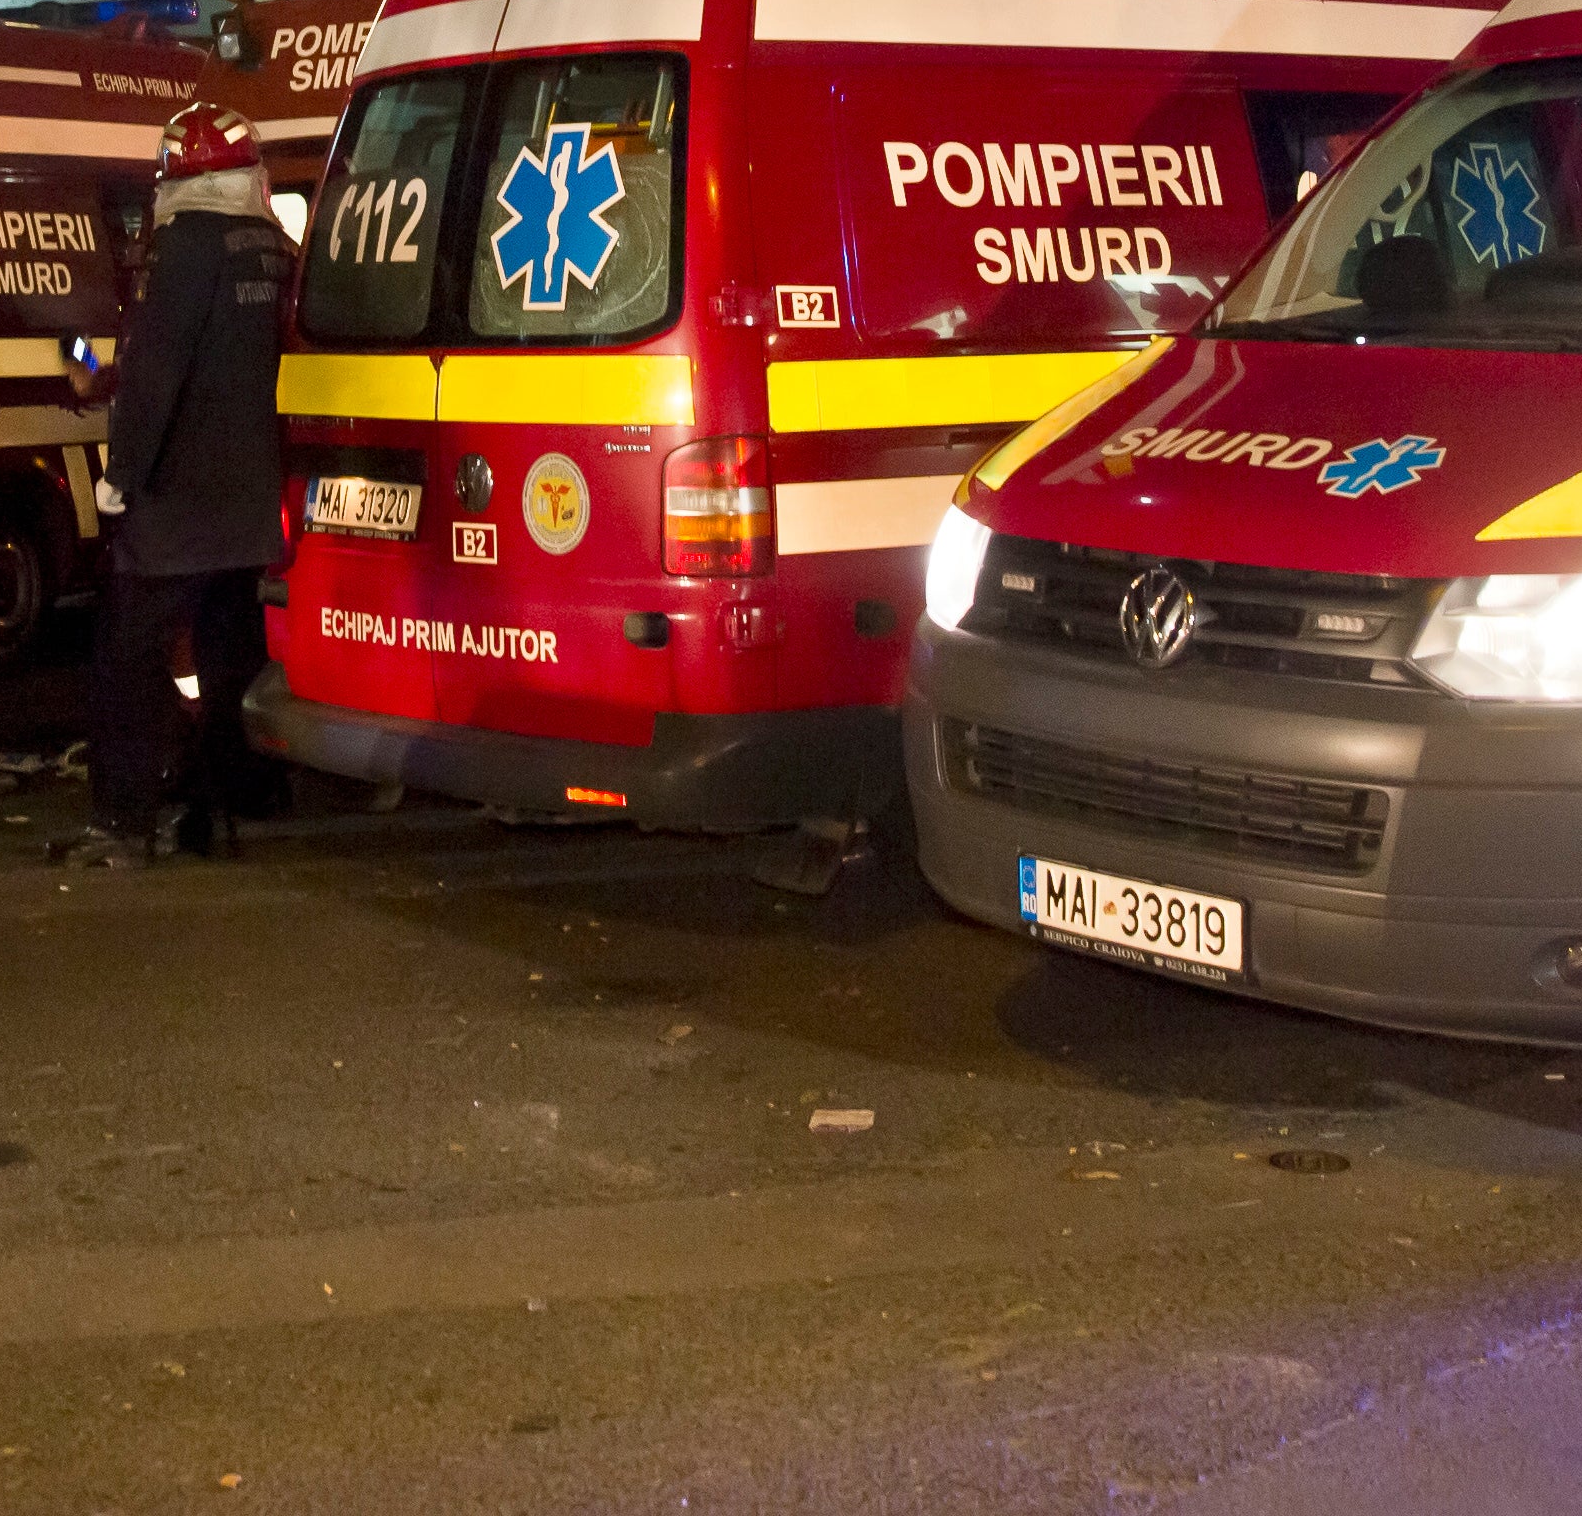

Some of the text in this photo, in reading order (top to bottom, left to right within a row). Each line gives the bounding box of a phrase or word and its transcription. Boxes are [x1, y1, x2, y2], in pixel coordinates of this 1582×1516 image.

[271, 21, 373, 60] POMP
[93, 72, 144, 96] ECHIPAJ
[144, 77, 174, 98] PRIM
[883, 141, 1223, 208] POMPIERII
[353, 177, 428, 264] 112
[974, 226, 1174, 284] SMURD
[792, 292, 825, 322] B2
[1101, 426, 1333, 471] SMURD
[317, 484, 410, 526] MAI 31320
[462, 528, 487, 558] B2
[321, 606, 559, 664] ECHIPAJ PRIM AJUTOR
[1023, 891, 1037, 913] RO
[1046, 867, 1225, 957] MAI 33819
[1043, 929, 1146, 964] SERPICO CRAIOVA
